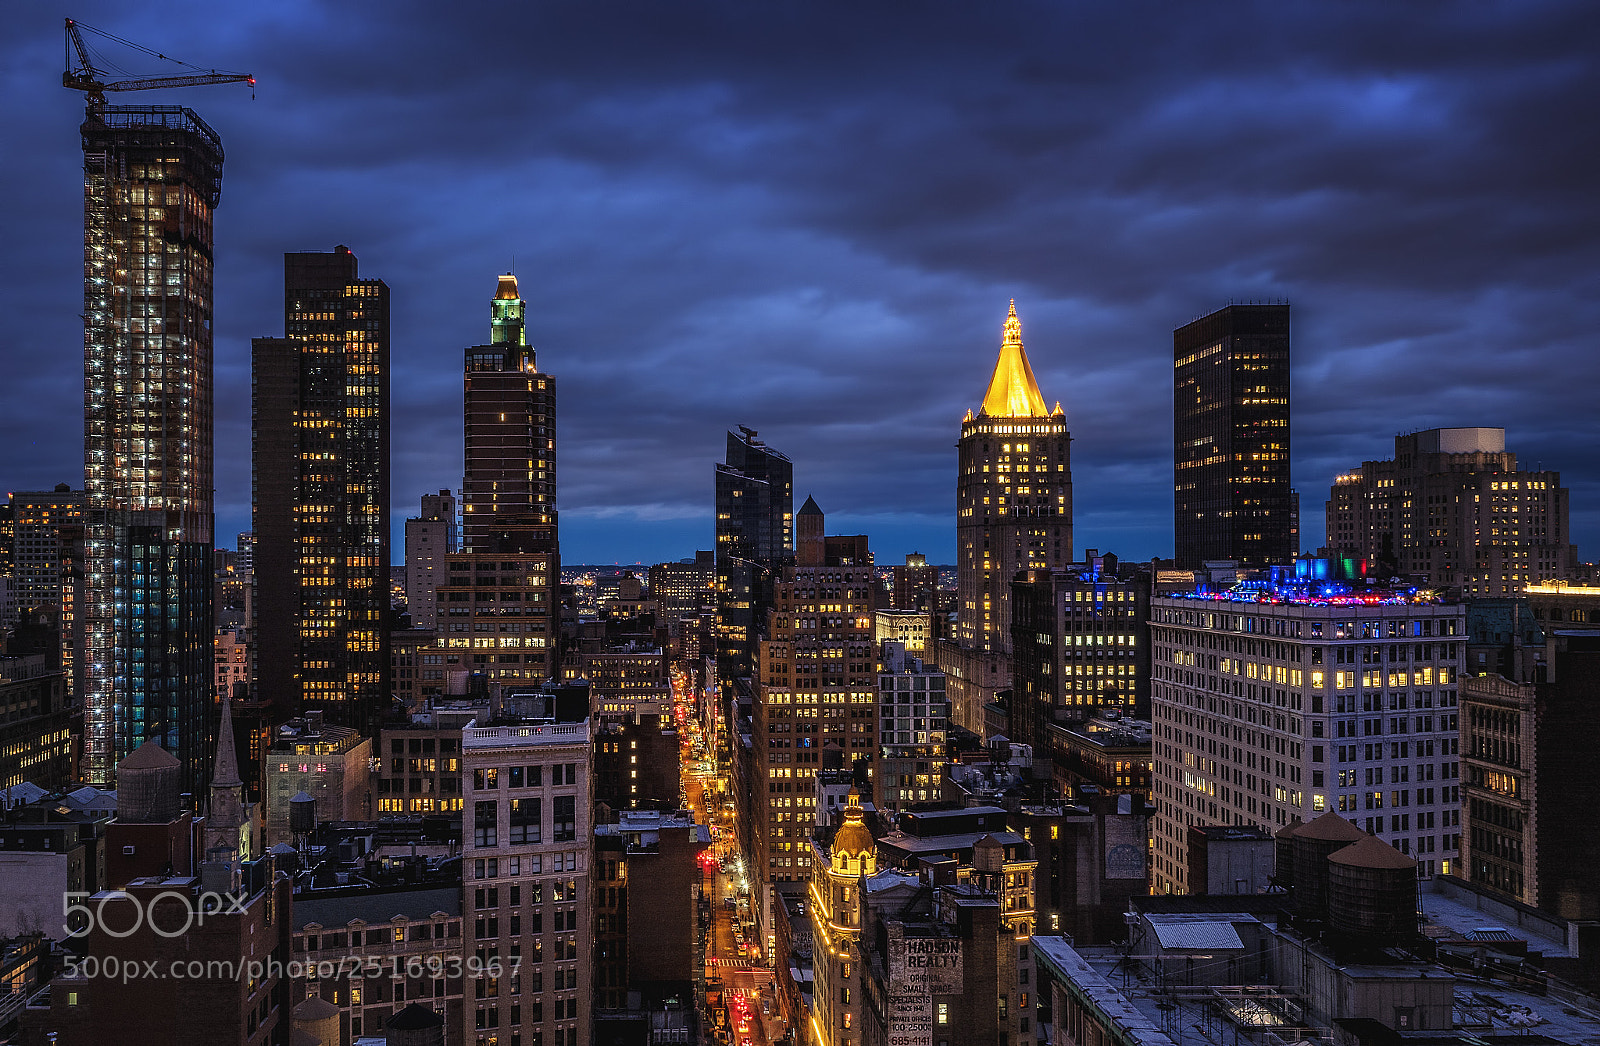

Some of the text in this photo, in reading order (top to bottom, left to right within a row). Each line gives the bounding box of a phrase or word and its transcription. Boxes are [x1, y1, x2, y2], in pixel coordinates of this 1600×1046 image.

[908, 941, 959, 953] HADSON
[908, 956, 958, 967] REALTY
[910, 974, 942, 983] ORIGINAL
[903, 984, 953, 994] SMALL SPACE
[889, 996, 931, 1004] SPECIALISTS
